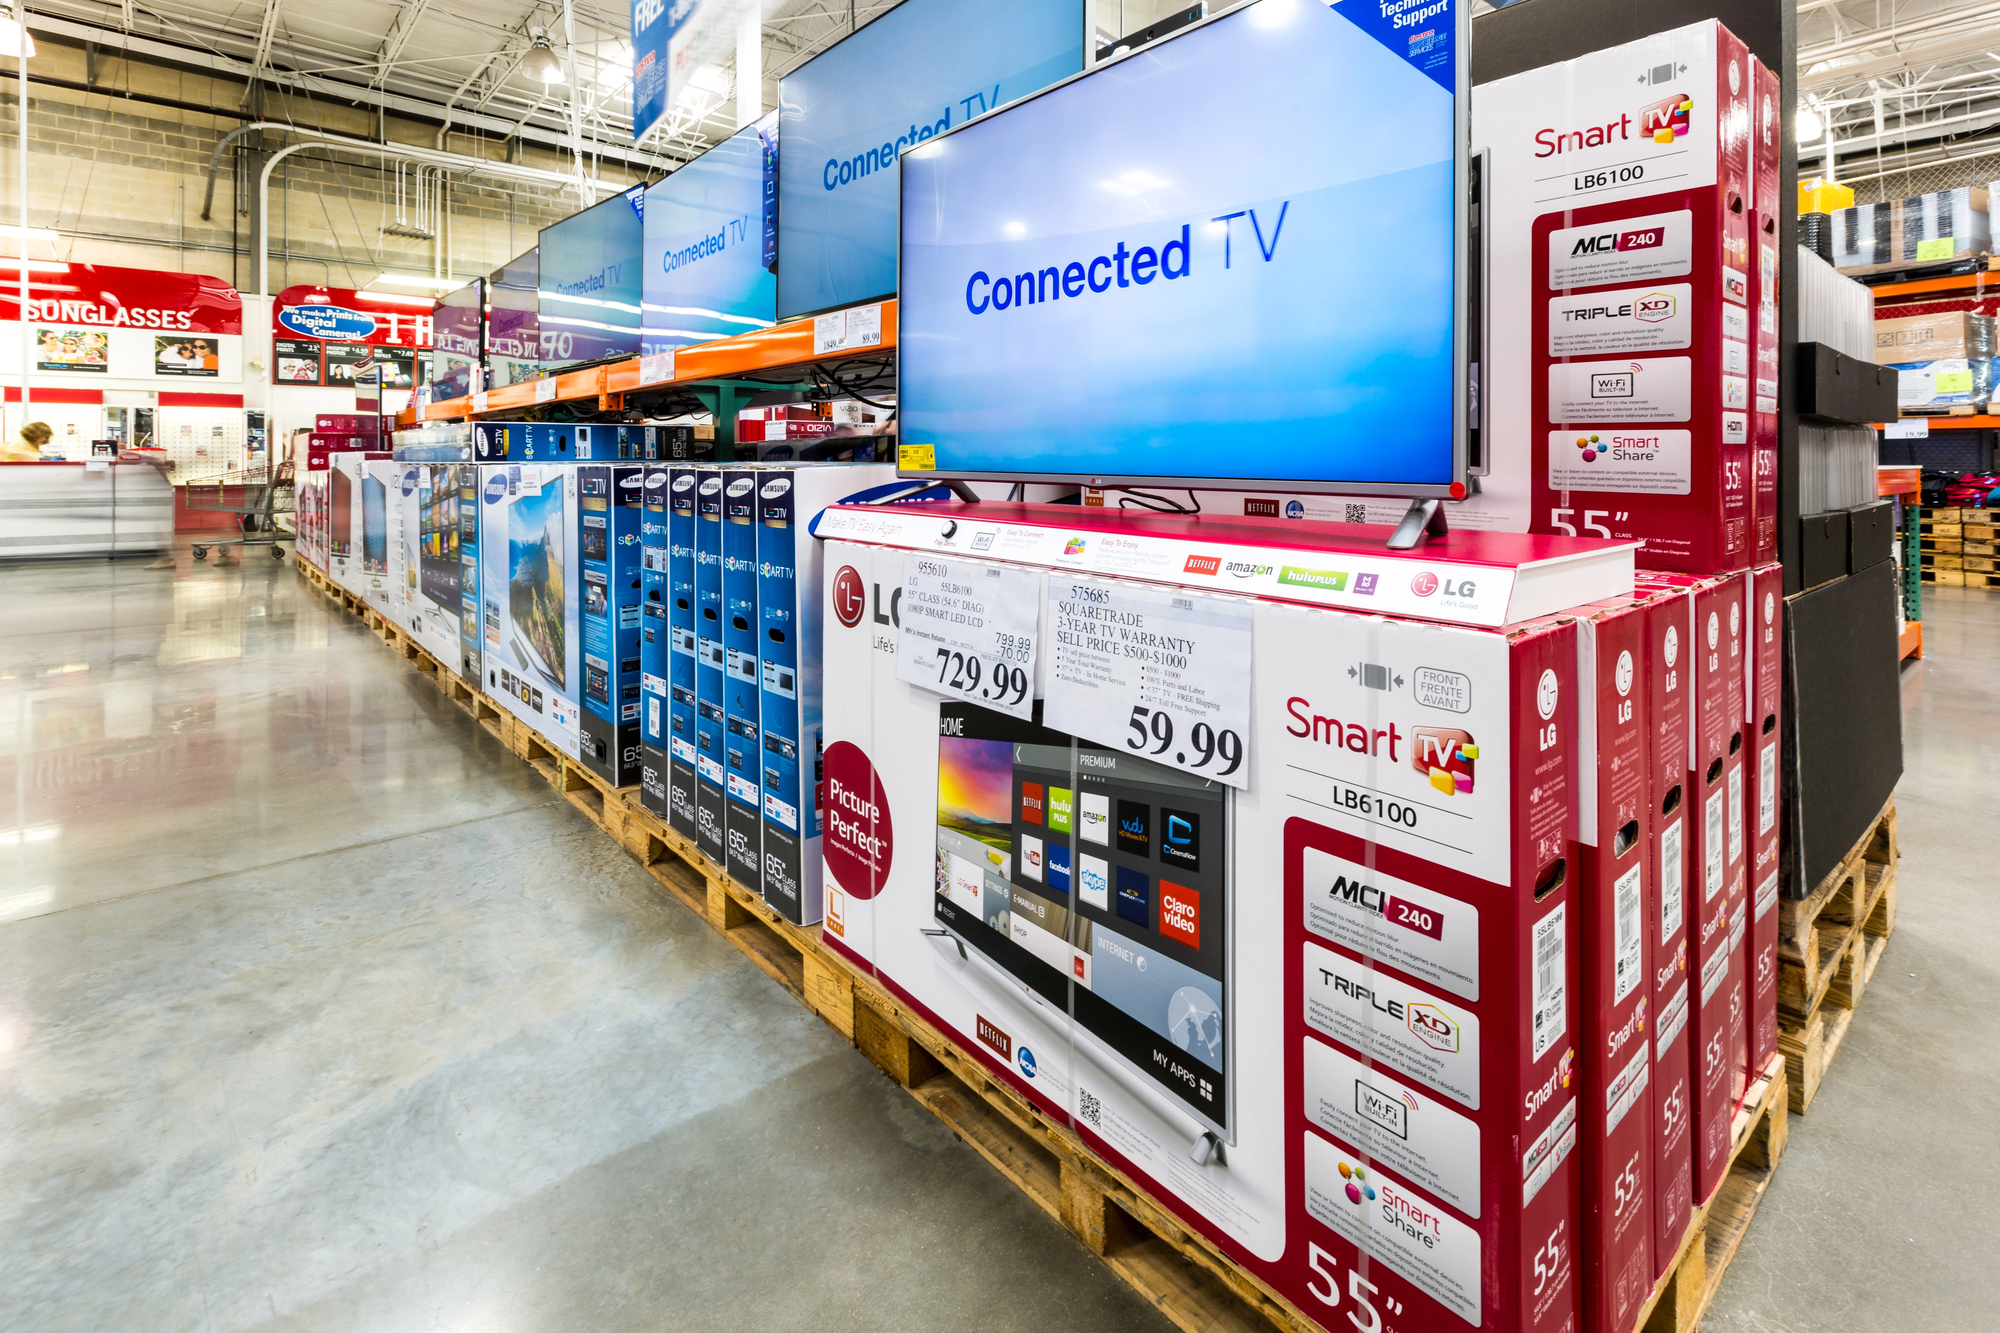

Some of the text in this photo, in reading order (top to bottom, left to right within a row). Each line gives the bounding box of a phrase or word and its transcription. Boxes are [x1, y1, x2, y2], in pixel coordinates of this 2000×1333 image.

[1393, 1, 1448, 29] Support
[823, 84, 1000, 191] Connected TV
[1534, 104, 1676, 158] Smart TV
[1574, 165, 1644, 191] LB6100
[663, 215, 748, 274] Connected TV
[1571, 232, 1656, 255] MCI 240
[966, 200, 1290, 315] Connected TV
[556, 263, 622, 297] Connected TV
[28, 299, 191, 330] SUNGLASSES
[283, 305, 376, 323] We make Prints from
[291, 314, 336, 328] Digital
[1562, 300, 1670, 322] TRIPLE XD
[1638, 309, 1670, 318] ENGINE
[312, 326, 361, 339] Cameras!
[1598, 379, 1626, 388] Wi-Fi
[1612, 436, 1660, 449] Smart
[1904, 430, 1928, 438] 19.99
[486, 481, 507, 496] SAMSUNG
[675, 479, 692, 487] SAMSUNG
[702, 482, 721, 490] SAMSUNG
[730, 484, 750, 492] SAMSUNG
[764, 485, 787, 493] SAMSUNG
[1247, 502, 1275, 514] NETFLIX
[826, 516, 902, 538] Make TV Easy Again
[1007, 529, 1017, 537] Easy
[1023, 531, 1044, 539] Connect
[934, 539, 957, 548] Play Demo
[1101, 538, 1139, 550] Easy To Enjoy
[918, 561, 948, 578] 955610
[1188, 558, 1217, 571] NETFLIX
[1226, 560, 1273, 576] amazon
[909, 576, 973, 597] LG 55LB6100
[1071, 585, 1110, 604] 575685
[1444, 578, 1476, 599] LG
[907, 589, 918, 599] 55"
[918, 592, 940, 604] CLASS
[962, 599, 984, 615] DIAG)
[1440, 599, 1478, 610] Life's Good
[907, 603, 984, 629] 1080P SMART LED LCD
[1058, 601, 1144, 628] SQUARETRADE
[873, 634, 895, 654] Life's
[916, 629, 931, 639] Instant
[931, 633, 946, 643] Rebate
[995, 632, 1031, 651] 799.99
[1057, 616, 1196, 655] 3-YEAR TV WARRANTY
[1765, 626, 1774, 644] LG
[996, 645, 1030, 664] -70.00
[1057, 630, 1188, 670] SELL PRICE $500-$1000
[1069, 649, 1078, 657] sell
[1078, 650, 1090, 661] price
[1091, 652, 1111, 664] between
[1731, 639, 1739, 658] LG
[1065, 656, 1076, 665] Year
[1077, 659, 1089, 668] Total
[1090, 662, 1112, 675] Warranty
[1146, 666, 1181, 680] $500 $1000
[1709, 652, 1719, 673] LG
[936, 647, 1028, 706] 729.99
[1060, 673, 1099, 689] Zero Deductibles
[1146, 675, 1206, 696] 100% Parts and Labor
[1423, 671, 1460, 687] FRONT
[1665, 670, 1677, 693] LG
[1420, 682, 1463, 699] FRENTE
[1144, 695, 1207, 717] 24/7 Toll Free Support
[1423, 694, 1461, 710] AVANT
[1618, 699, 1632, 725] LG
[940, 717, 964, 736] HOME
[1286, 696, 1457, 768] Smart TV
[1539, 722, 1557, 752] LG
[1126, 705, 1243, 776] 59.99
[1080, 754, 1116, 770] PREMIUM
[1534, 754, 1563, 776] www.lg.com
[830, 777, 880, 824] Picture
[1023, 797, 1042, 811] NETFLIX
[1051, 797, 1072, 813] hulu
[1333, 785, 1418, 828] LB6100
[1053, 812, 1068, 824] PLUS
[1082, 810, 1107, 824] amazon
[1121, 816, 1144, 834] vudu
[1170, 849, 1197, 861] CinemaNow
[1756, 848, 1771, 871] Smart
[1048, 860, 1072, 876] facebook
[985, 879, 1003, 895] SETTINGS
[1081, 869, 1107, 891] skype
[1013, 893, 1038, 914] E-MANUAL
[1163, 895, 1195, 918] Claro
[1329, 875, 1433, 931] MCI 240
[1013, 924, 1028, 937] SHOP
[1163, 911, 1195, 934] video
[1537, 911, 1563, 939] 55LB6100
[1702, 910, 1719, 945] Smart
[1097, 936, 1134, 965] INTERNET
[1657, 954, 1678, 992] Smart
[1617, 980, 1626, 997] US
[1319, 967, 1451, 1036] TRIPLE XD
[979, 1022, 1008, 1053] NETFLIX
[1413, 1023, 1452, 1047] ENGINE
[1153, 1049, 1196, 1088] MY APPS
[1363, 1092, 1397, 1119] Wi-Fi
[1364, 1104, 1398, 1127] BUILT-IN
[1382, 1186, 1441, 1236] Smart
